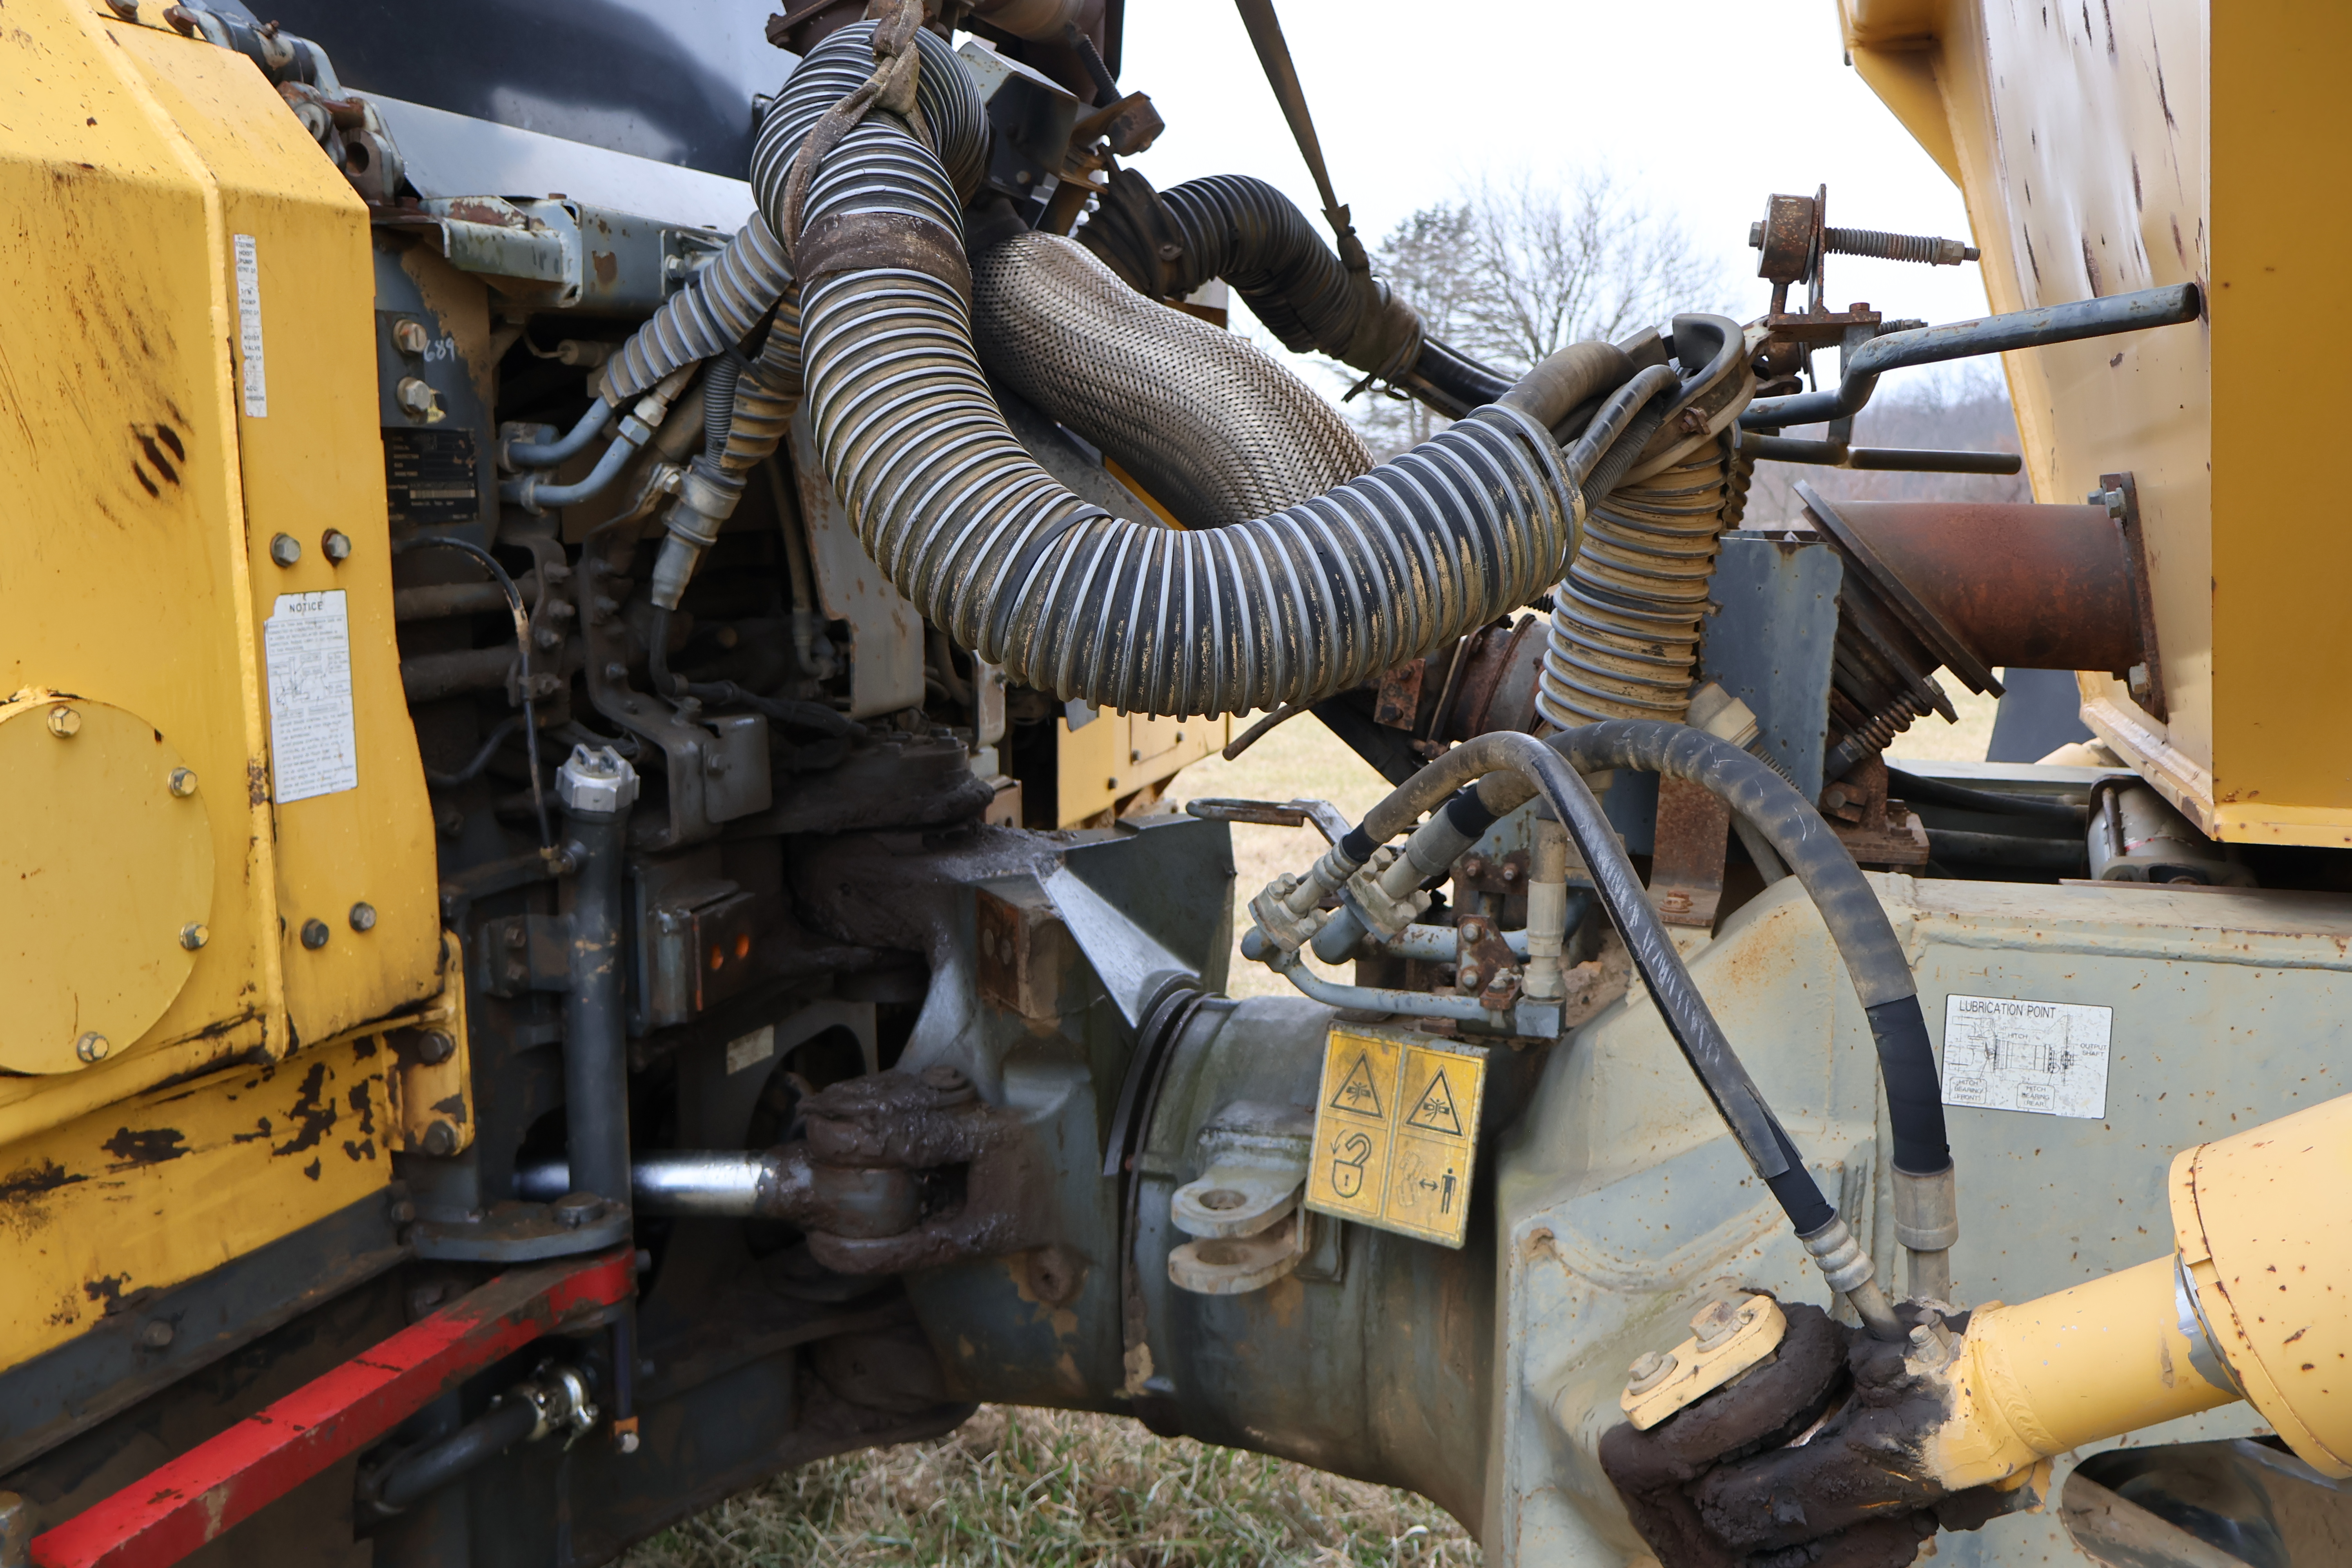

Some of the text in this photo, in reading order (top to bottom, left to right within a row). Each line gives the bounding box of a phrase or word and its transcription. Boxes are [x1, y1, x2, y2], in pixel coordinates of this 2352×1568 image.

[424, 337, 455, 362] 689
[289, 601, 323, 613] NOTICE
[1960, 1000, 2056, 1018] LUBRICATION POINT
